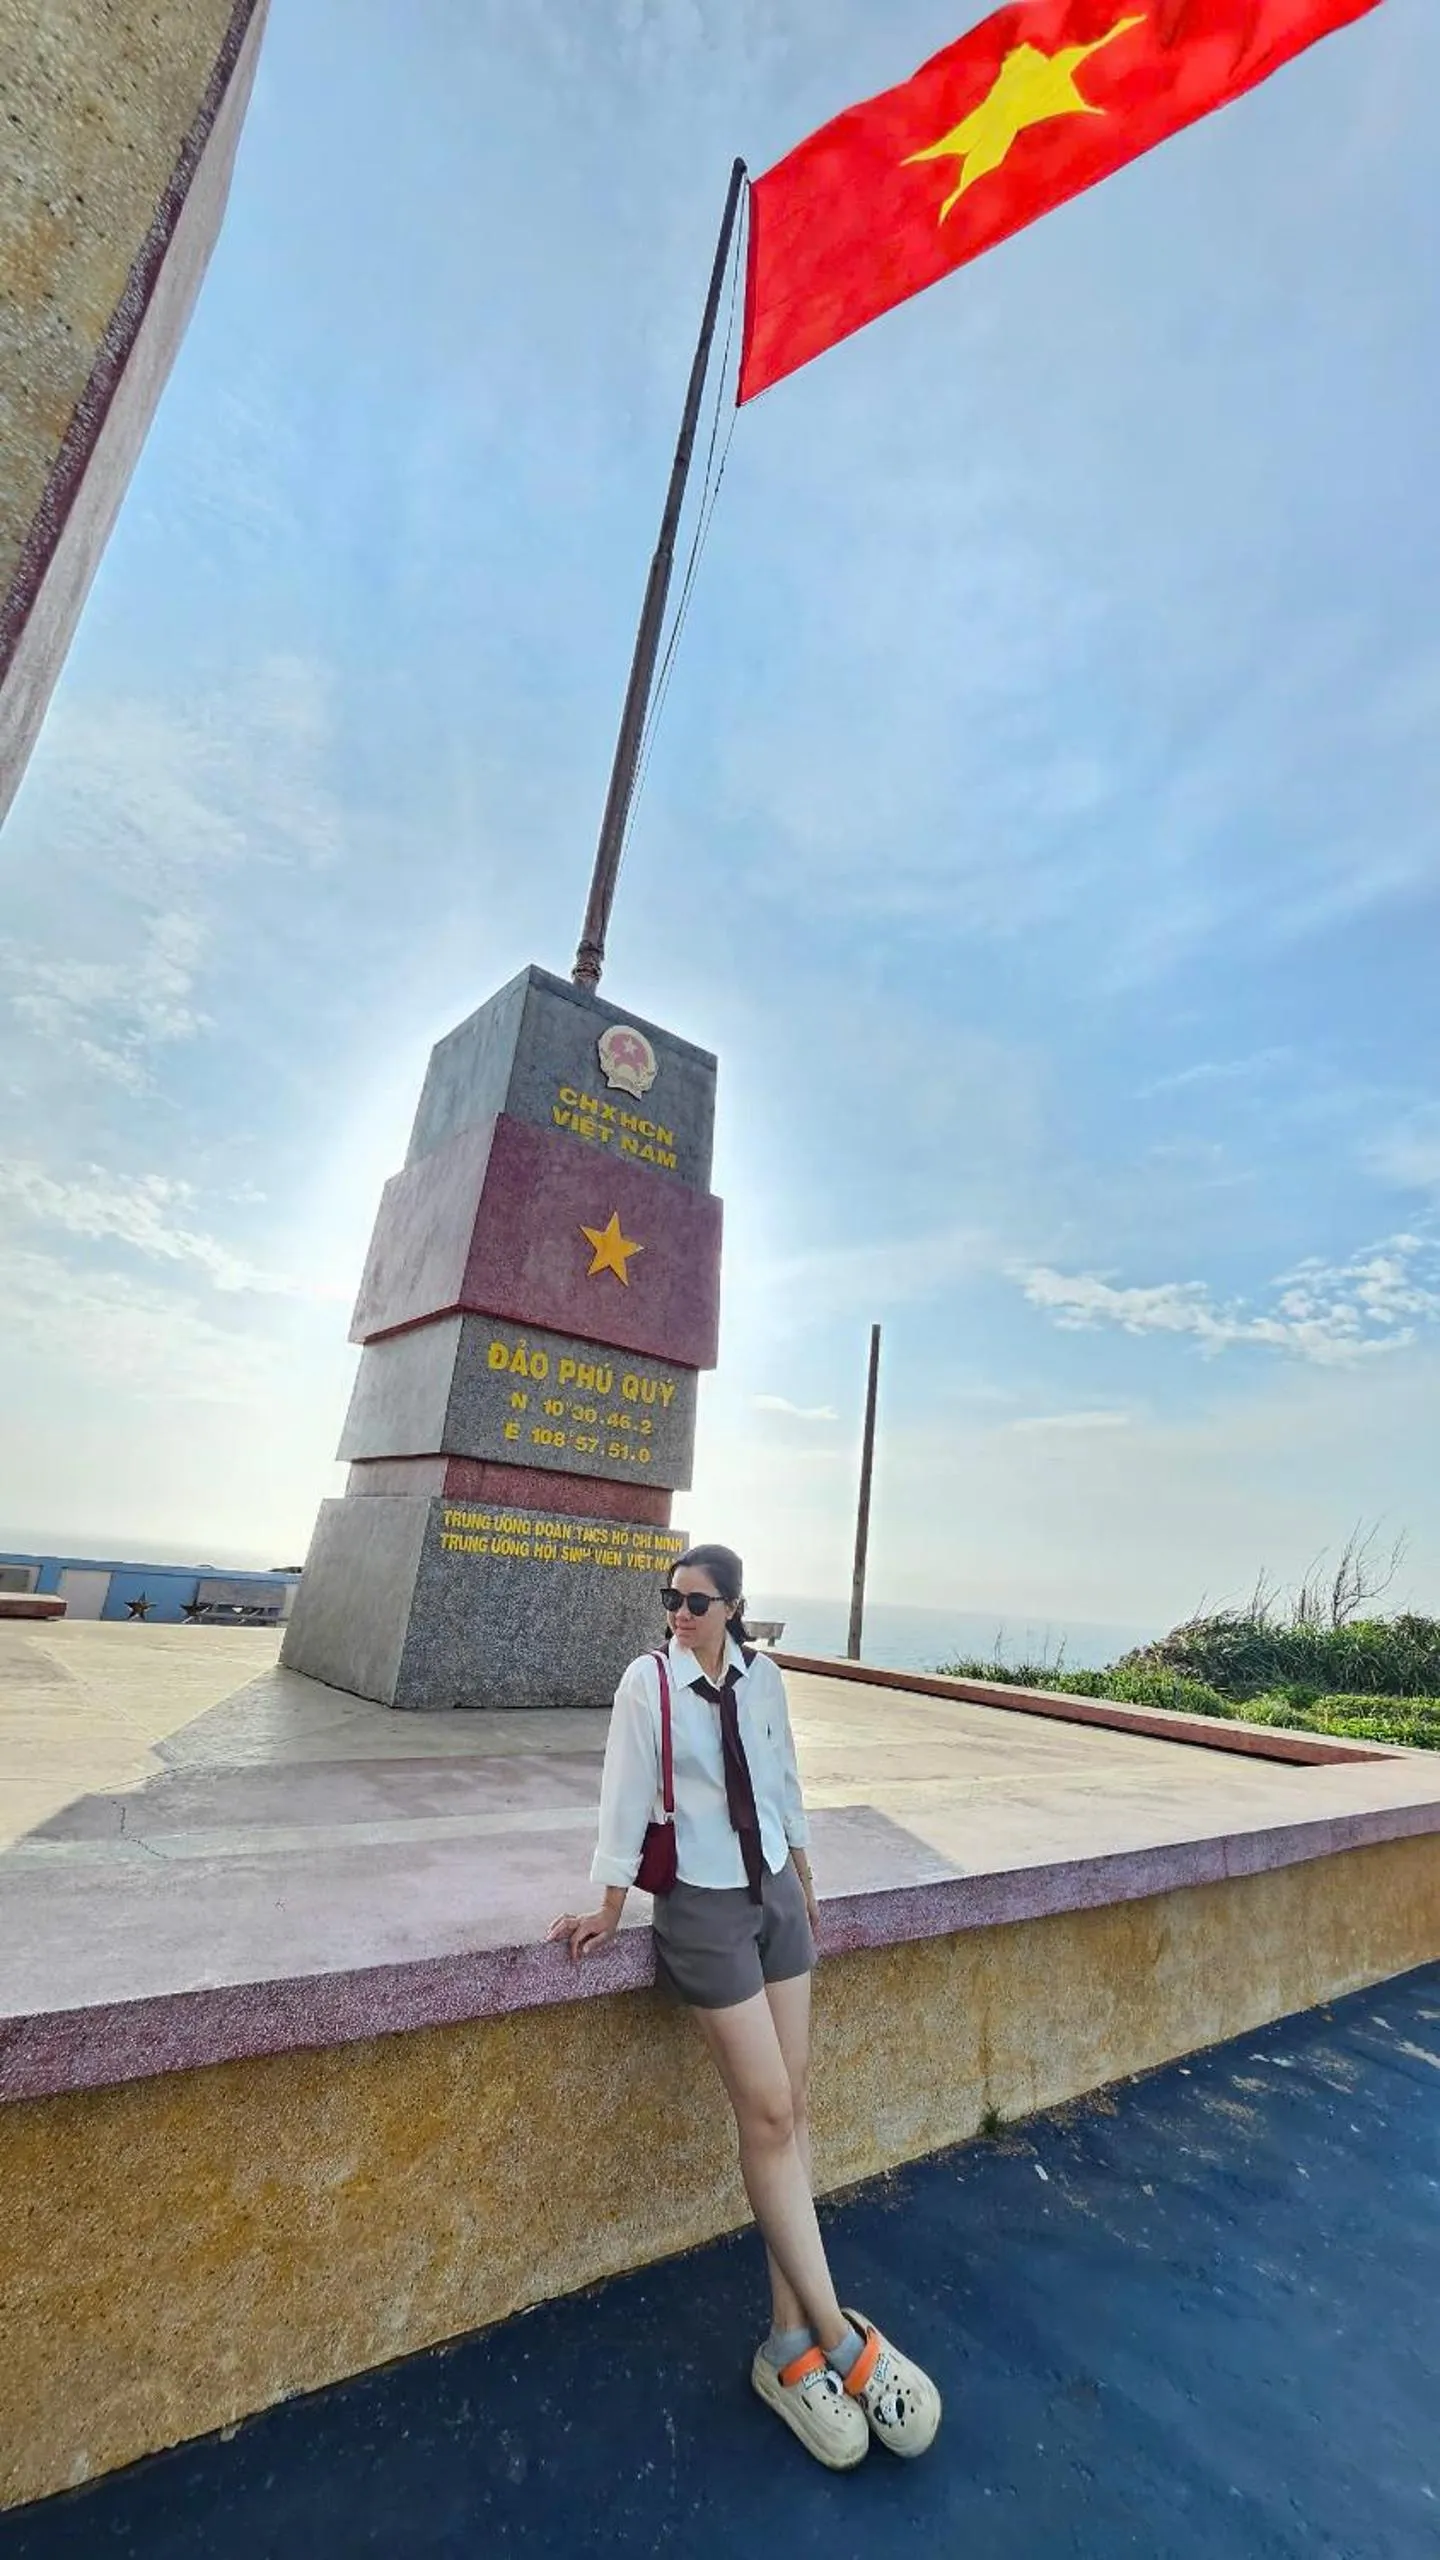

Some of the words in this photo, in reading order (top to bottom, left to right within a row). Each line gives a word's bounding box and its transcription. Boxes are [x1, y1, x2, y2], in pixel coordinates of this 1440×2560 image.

[552, 1105, 614, 1143] VIỆT
[620, 1135, 678, 1170] NAM
[559, 1087, 673, 1146] CHXHCN
[511, 1391, 528, 1411] N
[558, 1358, 613, 1394] PHÚ
[622, 1373, 676, 1408] QUÝ
[503, 1420, 521, 1441] E
[441, 1532, 489, 1554] TRUNG
[443, 1509, 492, 1530] TRUNG
[655, 1535, 684, 1552] MINH
